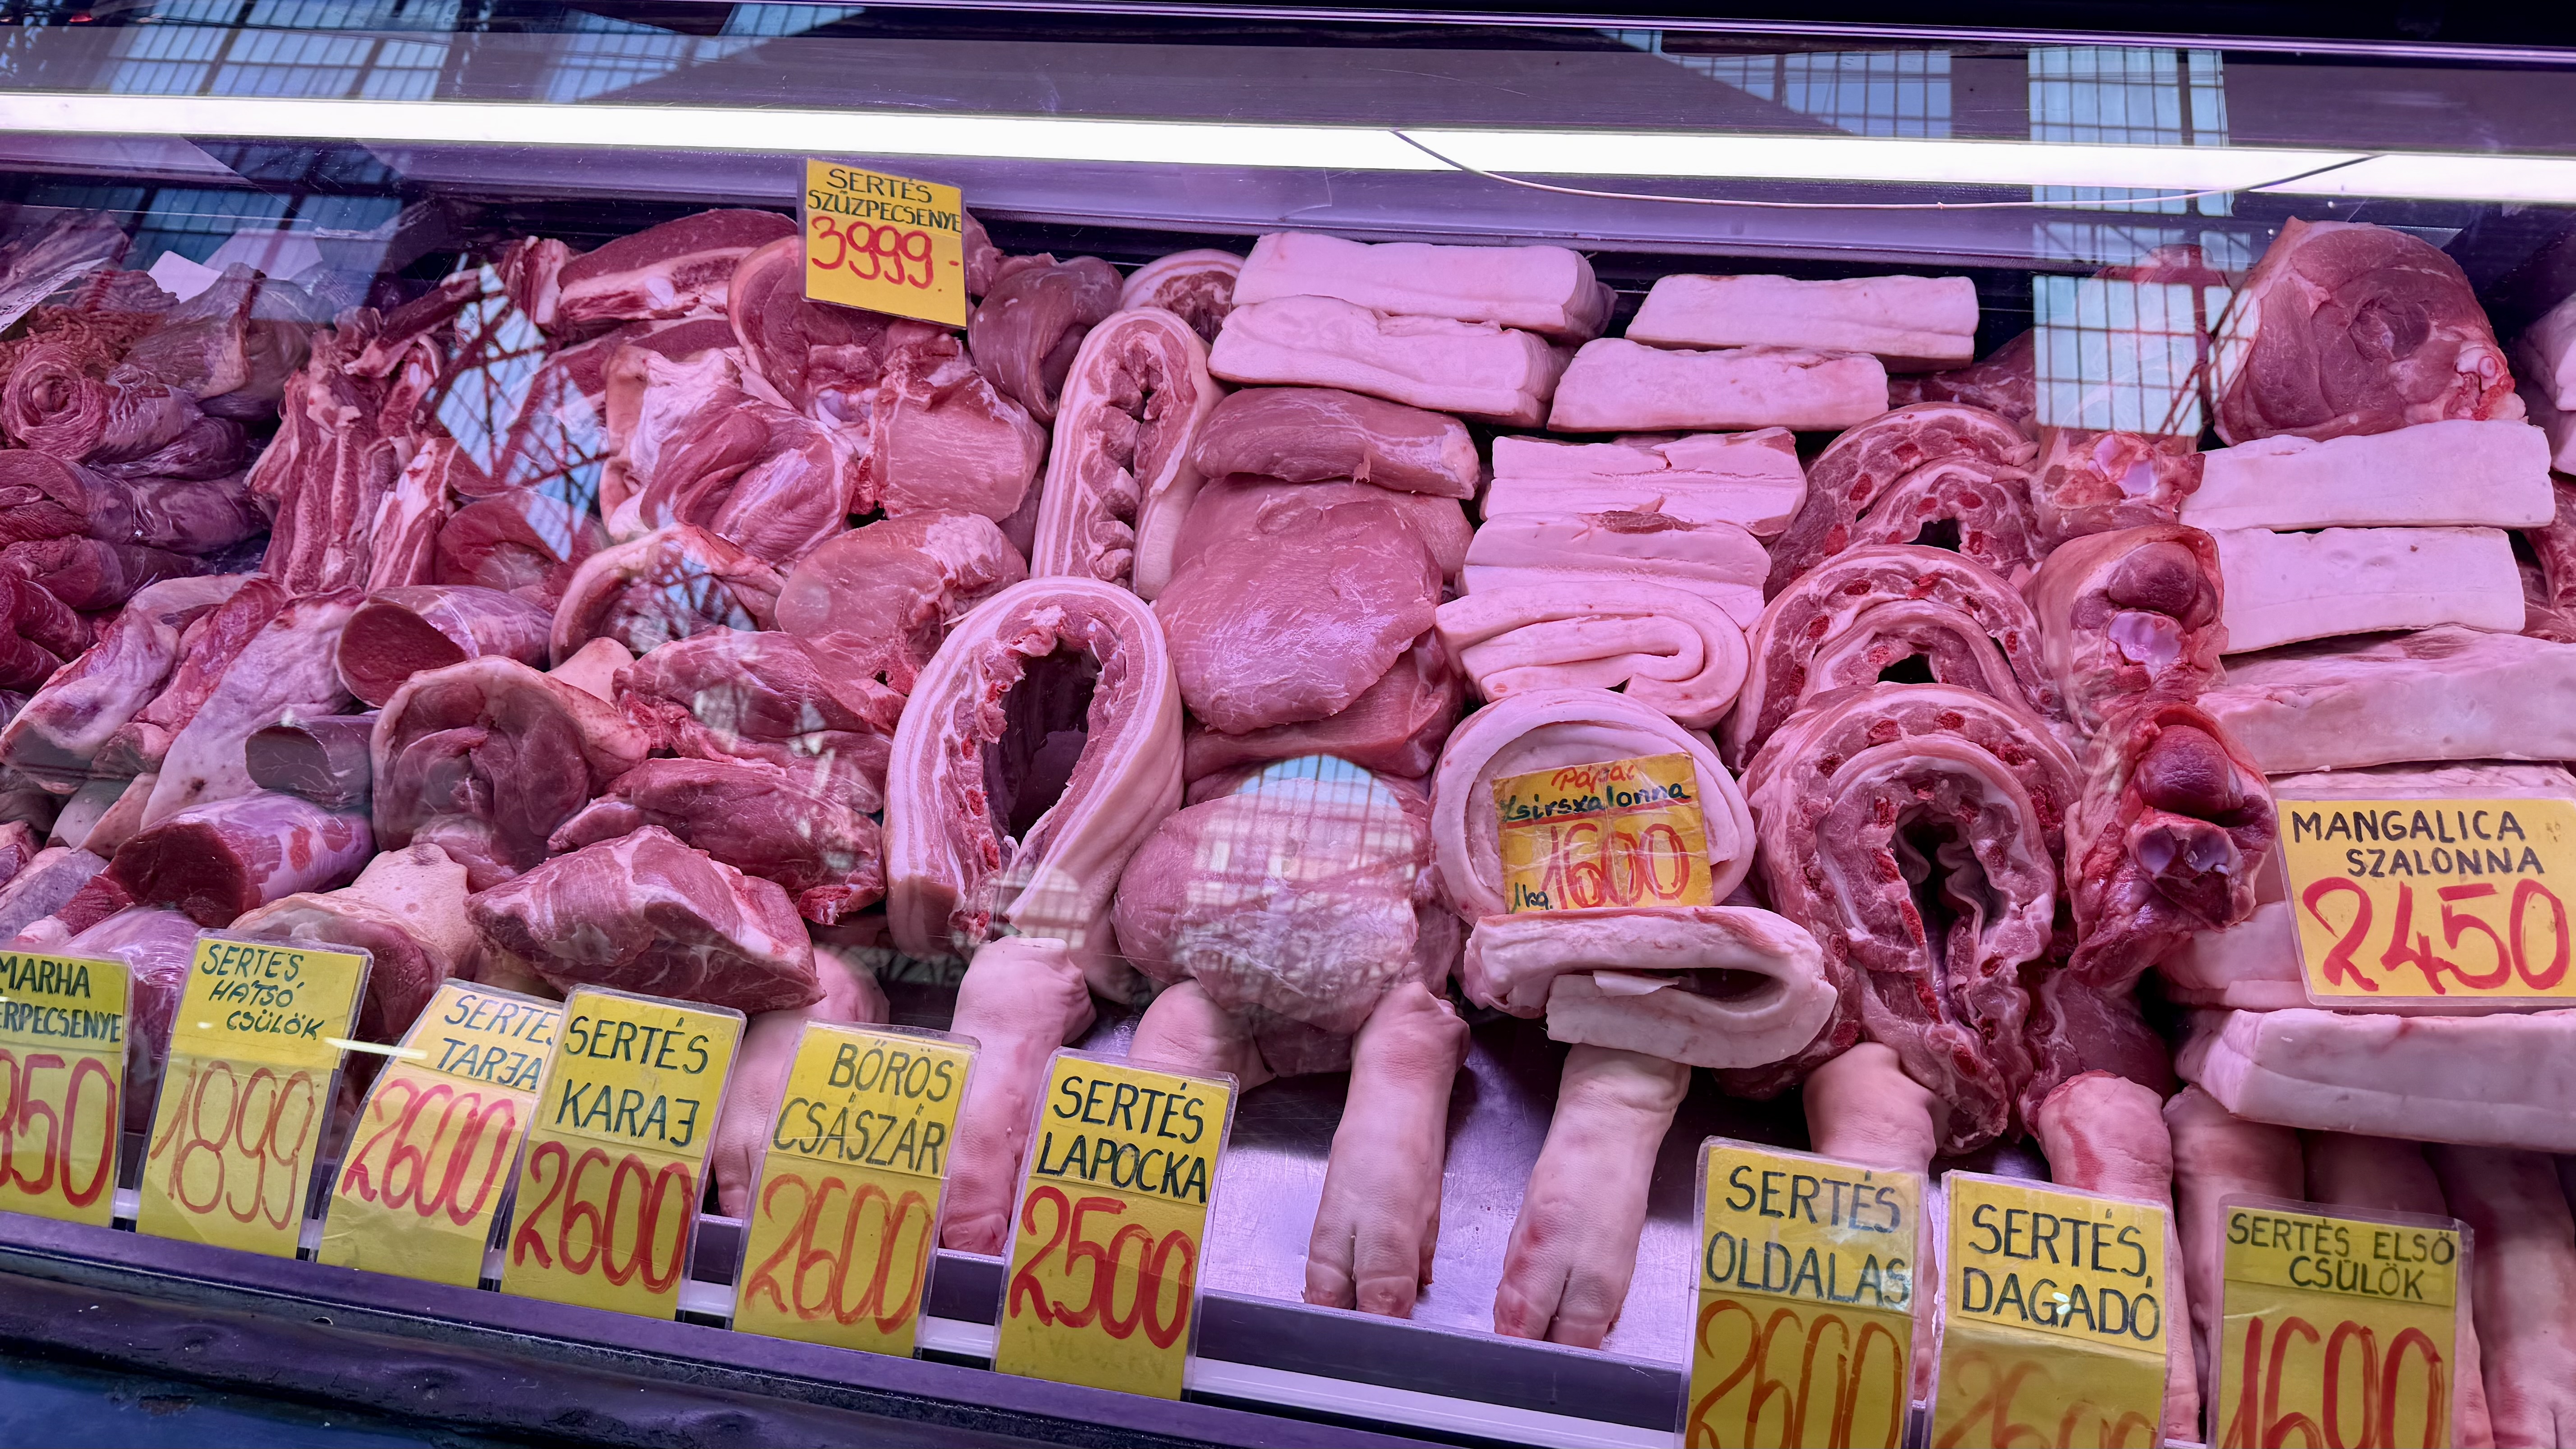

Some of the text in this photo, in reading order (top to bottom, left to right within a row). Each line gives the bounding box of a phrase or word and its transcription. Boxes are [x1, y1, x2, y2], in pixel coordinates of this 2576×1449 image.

[826, 169, 932, 203] SERTÉS
[2292, 810, 2526, 843] MANGALICA
[2346, 846, 2545, 877] SZALONNA
[1541, 823, 1689, 910] 1600
[2302, 876, 2570, 995] 2450
[226, 1009, 325, 1040] CSÜLÖK
[564, 1016, 709, 1074] SERTÉS
[149, 1058, 315, 1230] 1899
[556, 1079, 700, 1147] KARAJ
[773, 1092, 947, 1175] CSÁSZÁR
[1053, 1076, 1204, 1144] SERTÉS
[341, 1077, 515, 1226] 2600
[1036, 1131, 1207, 1204] LAPOCKA
[513, 1141, 695, 1294] 2600
[1725, 1165, 1902, 1233] SERTÉS
[2227, 1213, 2349, 1257] SERTÉS
[744, 1173, 934, 1335] 2600
[1009, 1185, 1197, 1349] 2500
[1706, 1231, 1909, 1307] OLDALAS
[1969, 1204, 2147, 1278] SERTÉS
[1962, 1266, 2160, 1341] DAGADÓ
[1685, 1299, 1903, 1449] 2600
[2222, 1316, 2445, 1449] 1600
